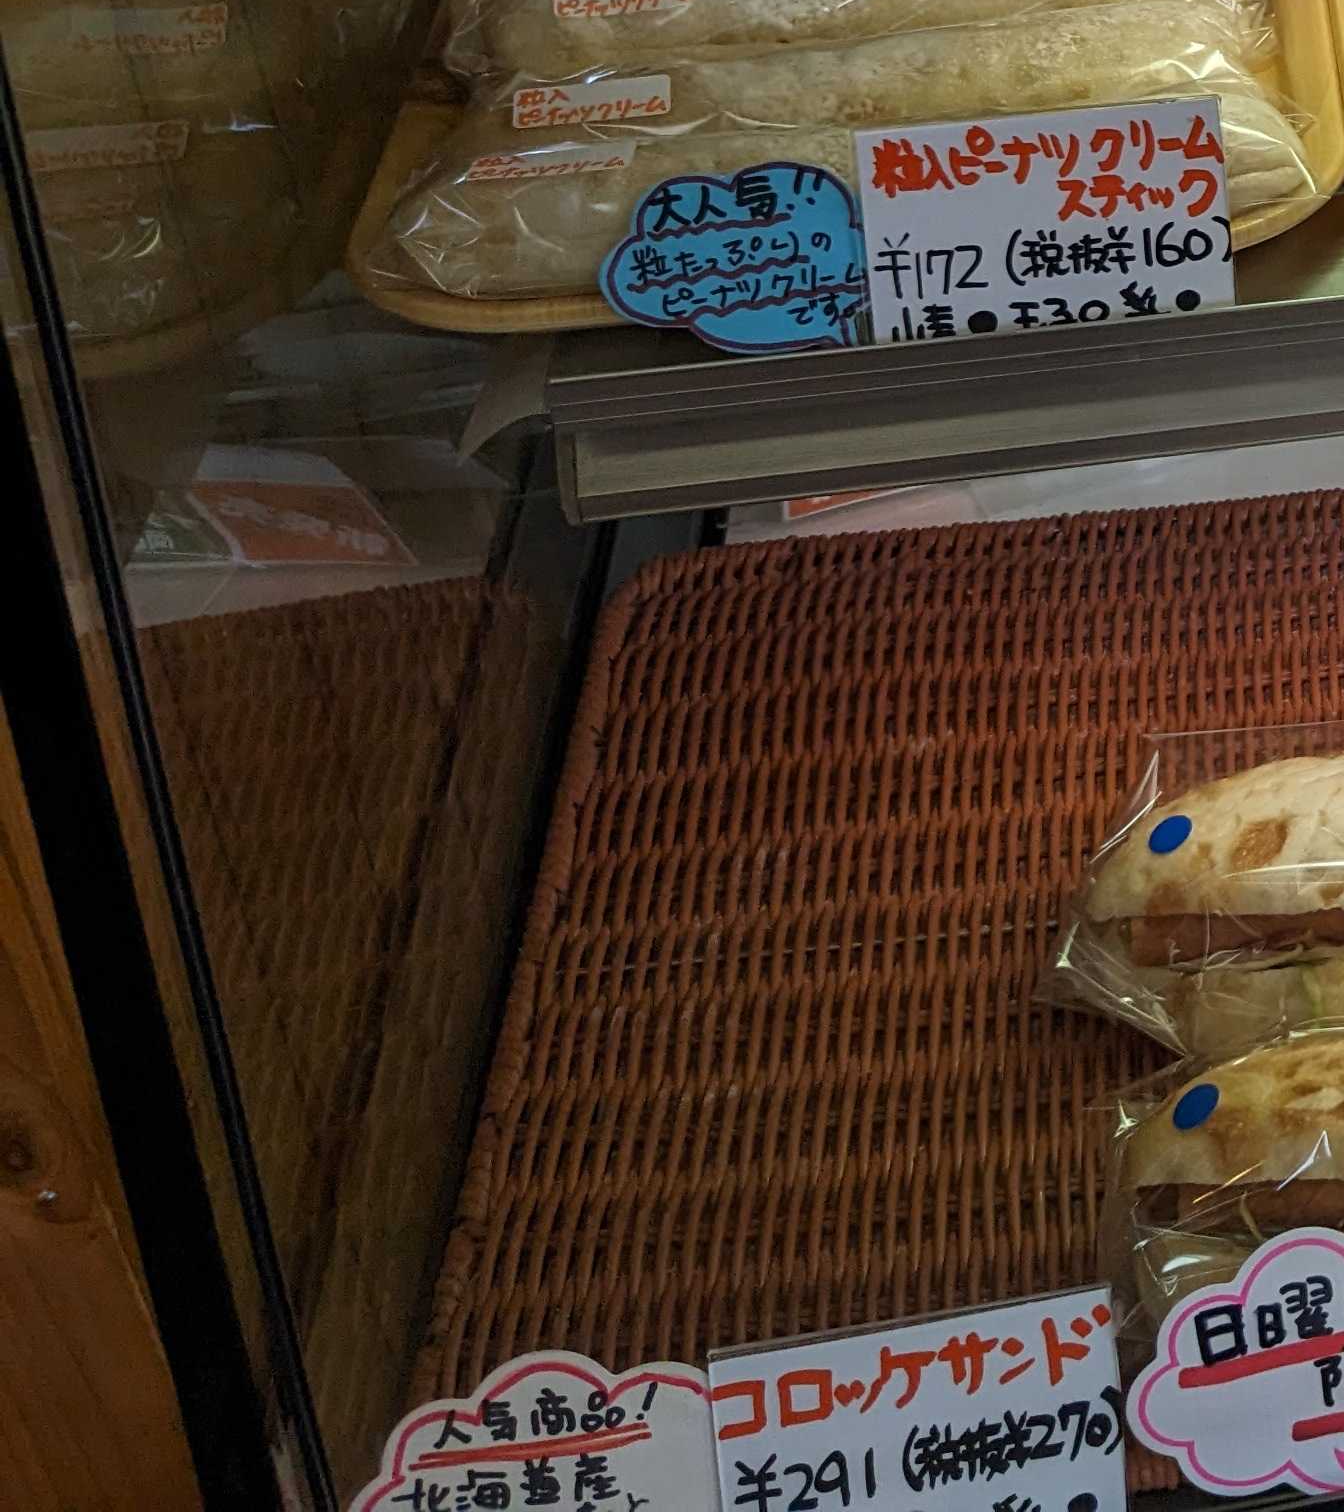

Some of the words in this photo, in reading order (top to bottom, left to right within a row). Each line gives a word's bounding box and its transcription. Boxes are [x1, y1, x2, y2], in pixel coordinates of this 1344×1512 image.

[1058, 169, 1219, 221] スティック
[874, 233, 989, 300] ¥172
[712, 1304, 1112, 1441] コロッケサンド
[434, 1381, 659, 1450] 人気商品!
[734, 1447, 876, 1512] ¥291
